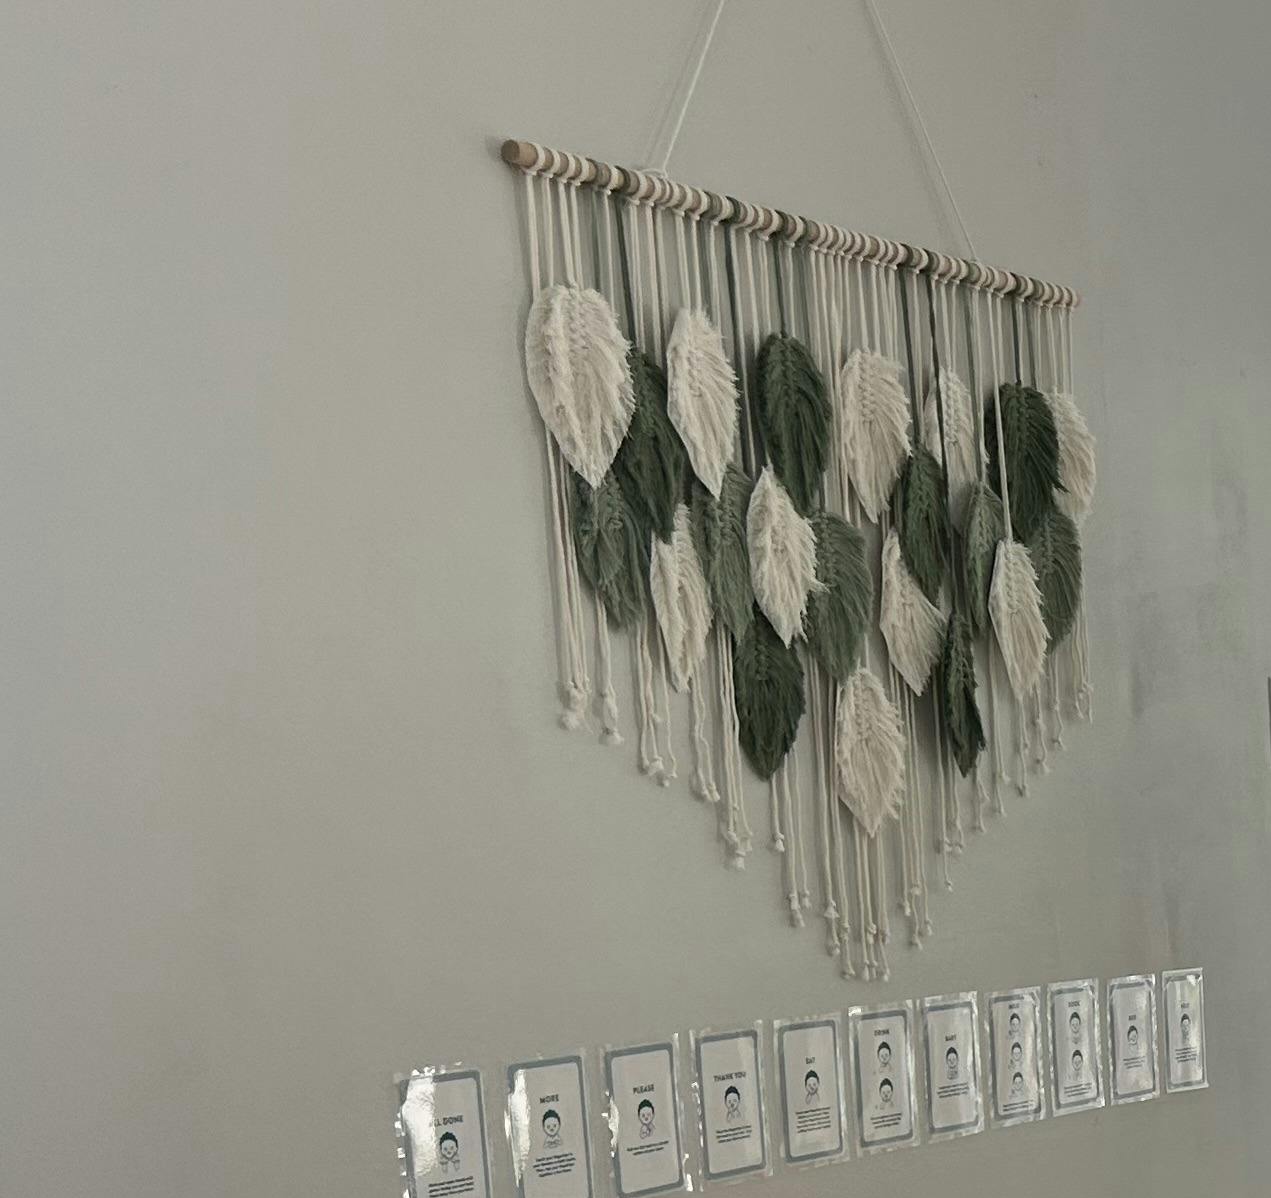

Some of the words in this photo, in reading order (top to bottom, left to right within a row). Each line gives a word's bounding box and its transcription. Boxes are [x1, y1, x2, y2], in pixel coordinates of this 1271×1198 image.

[713, 1072, 733, 1082] THANK
[734, 1071, 747, 1079] YOU
[632, 1083, 655, 1095] PLEASE
